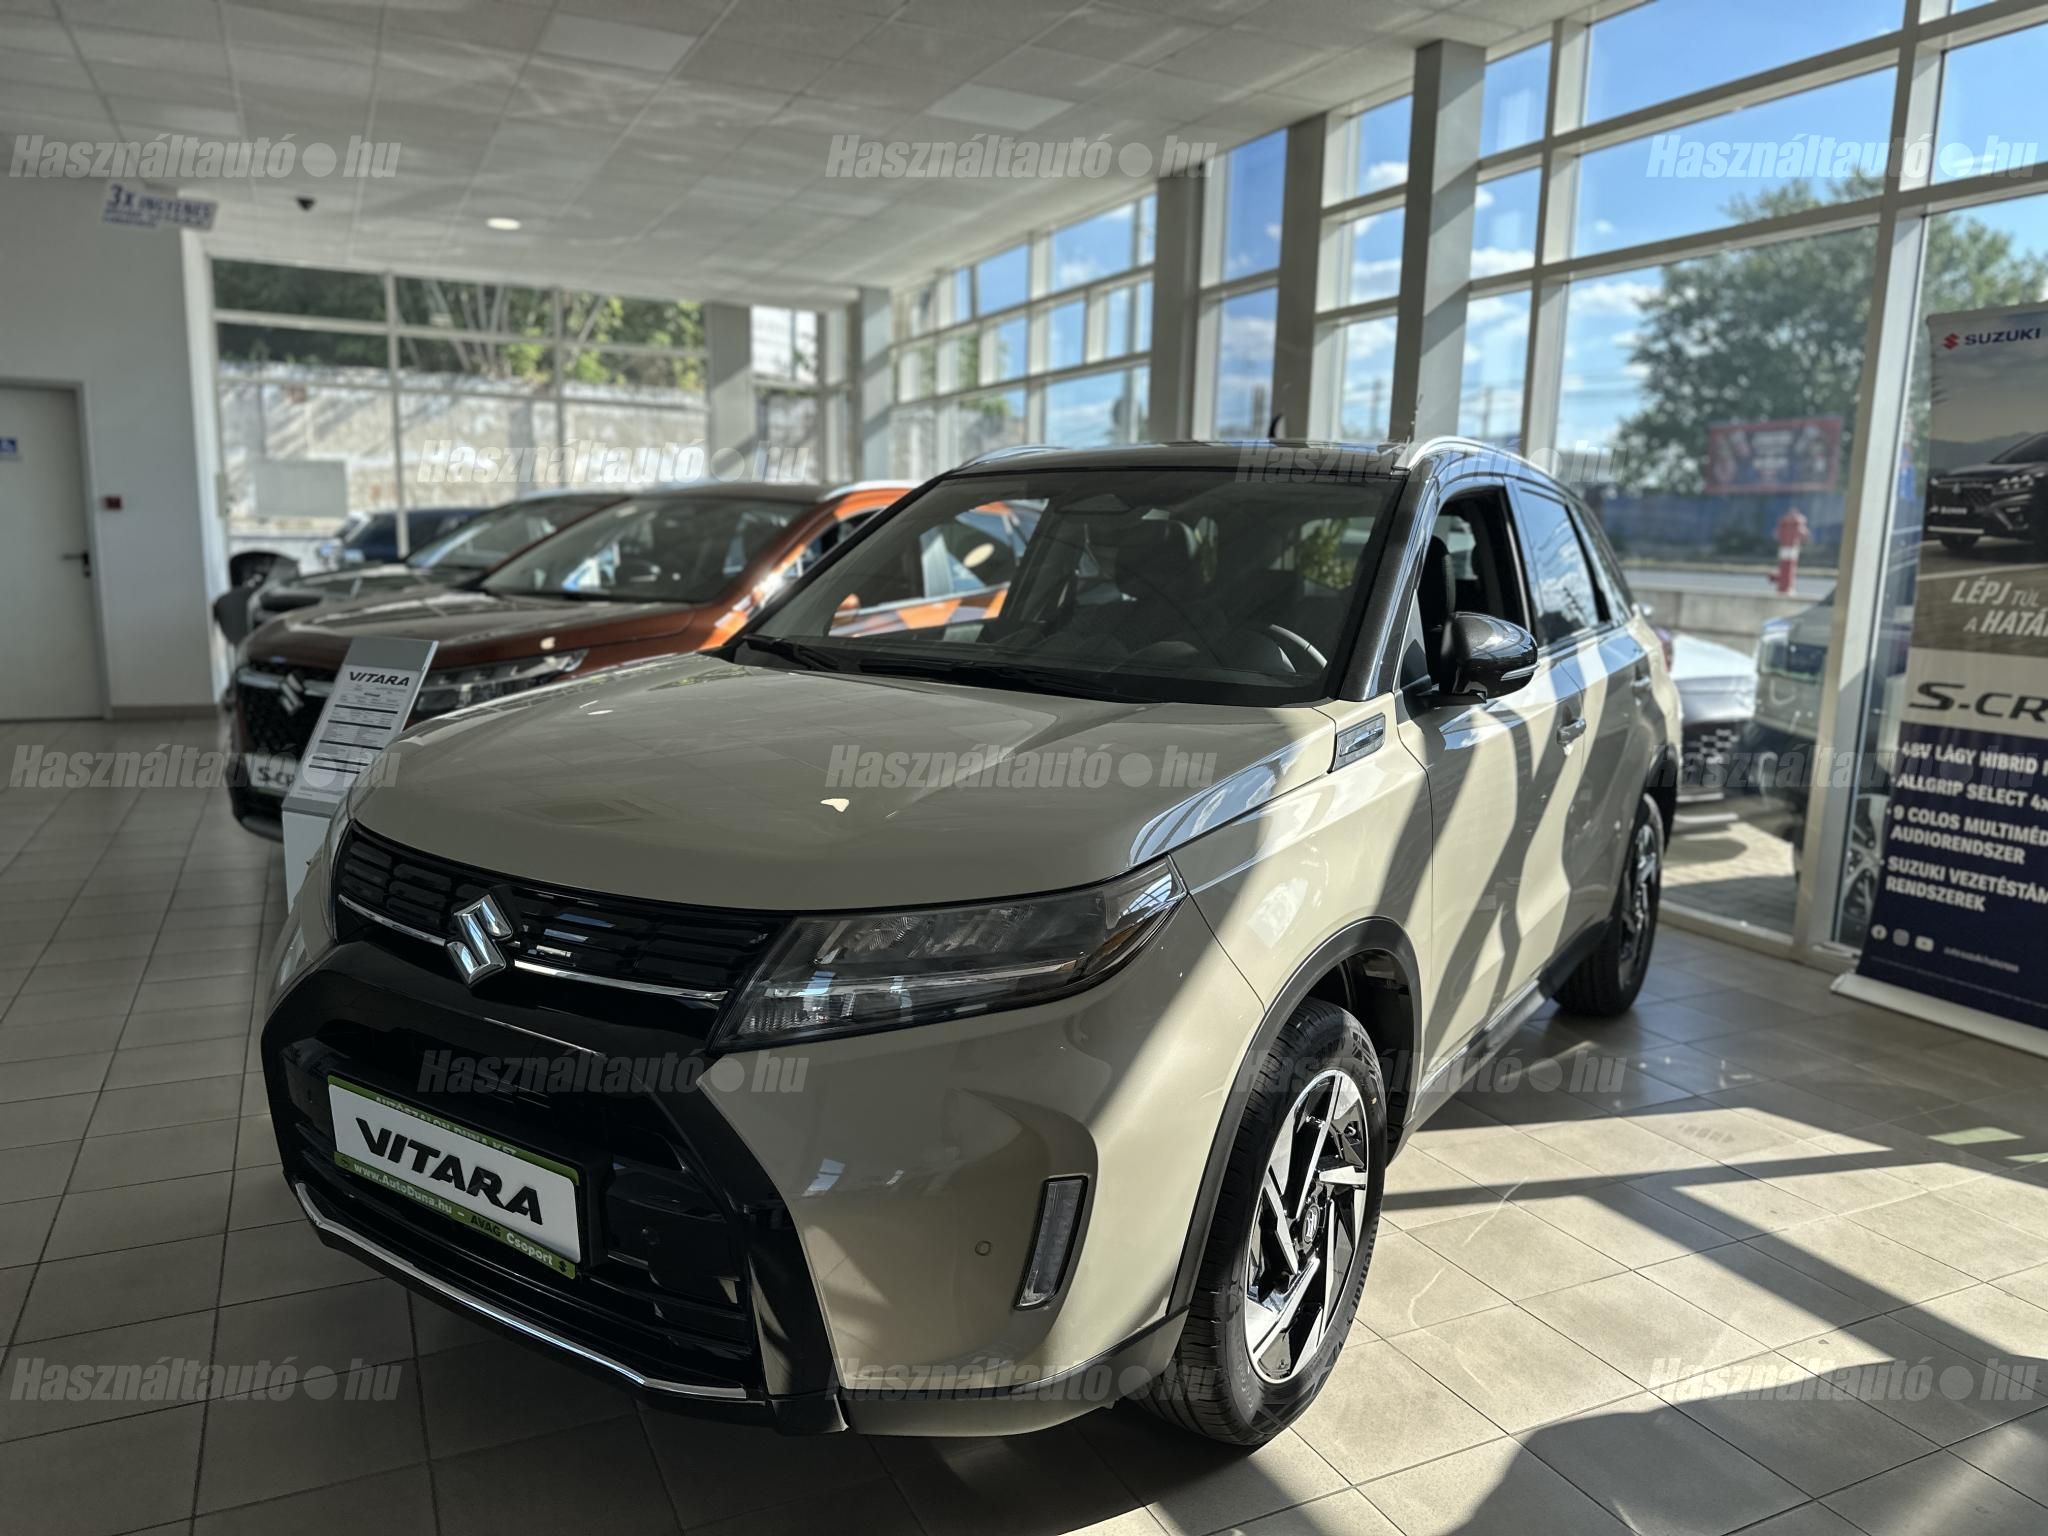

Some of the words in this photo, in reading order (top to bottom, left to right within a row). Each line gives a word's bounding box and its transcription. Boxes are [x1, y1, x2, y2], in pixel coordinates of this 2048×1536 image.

[1964, 328, 2041, 346] SUZUKI
[1952, 576, 2012, 606] LÉPJ
[2011, 587, 2040, 608] TÚL
[1963, 616, 1979, 632] A
[350, 671, 410, 687] VITARA
[1902, 742, 1933, 759] 48V
[1935, 744, 1977, 766] LÁGY
[1979, 751, 2039, 775] HIBRID
[1896, 773, 1964, 797] ALLGRIP
[1966, 783, 2029, 808] SELECT
[1893, 805, 1905, 821] 9
[1907, 807, 1961, 830] COLOS
[1890, 825, 2026, 865] AUDIORENDSZER
[1887, 855, 1947, 882] SUZUKI
[1885, 875, 1986, 912] RENDSZEREK
[356, 1117, 544, 1225] VITARA
[353, 1163, 453, 1214] www.AutoDuna.hu
[506, 1232, 554, 1266] Csoport
